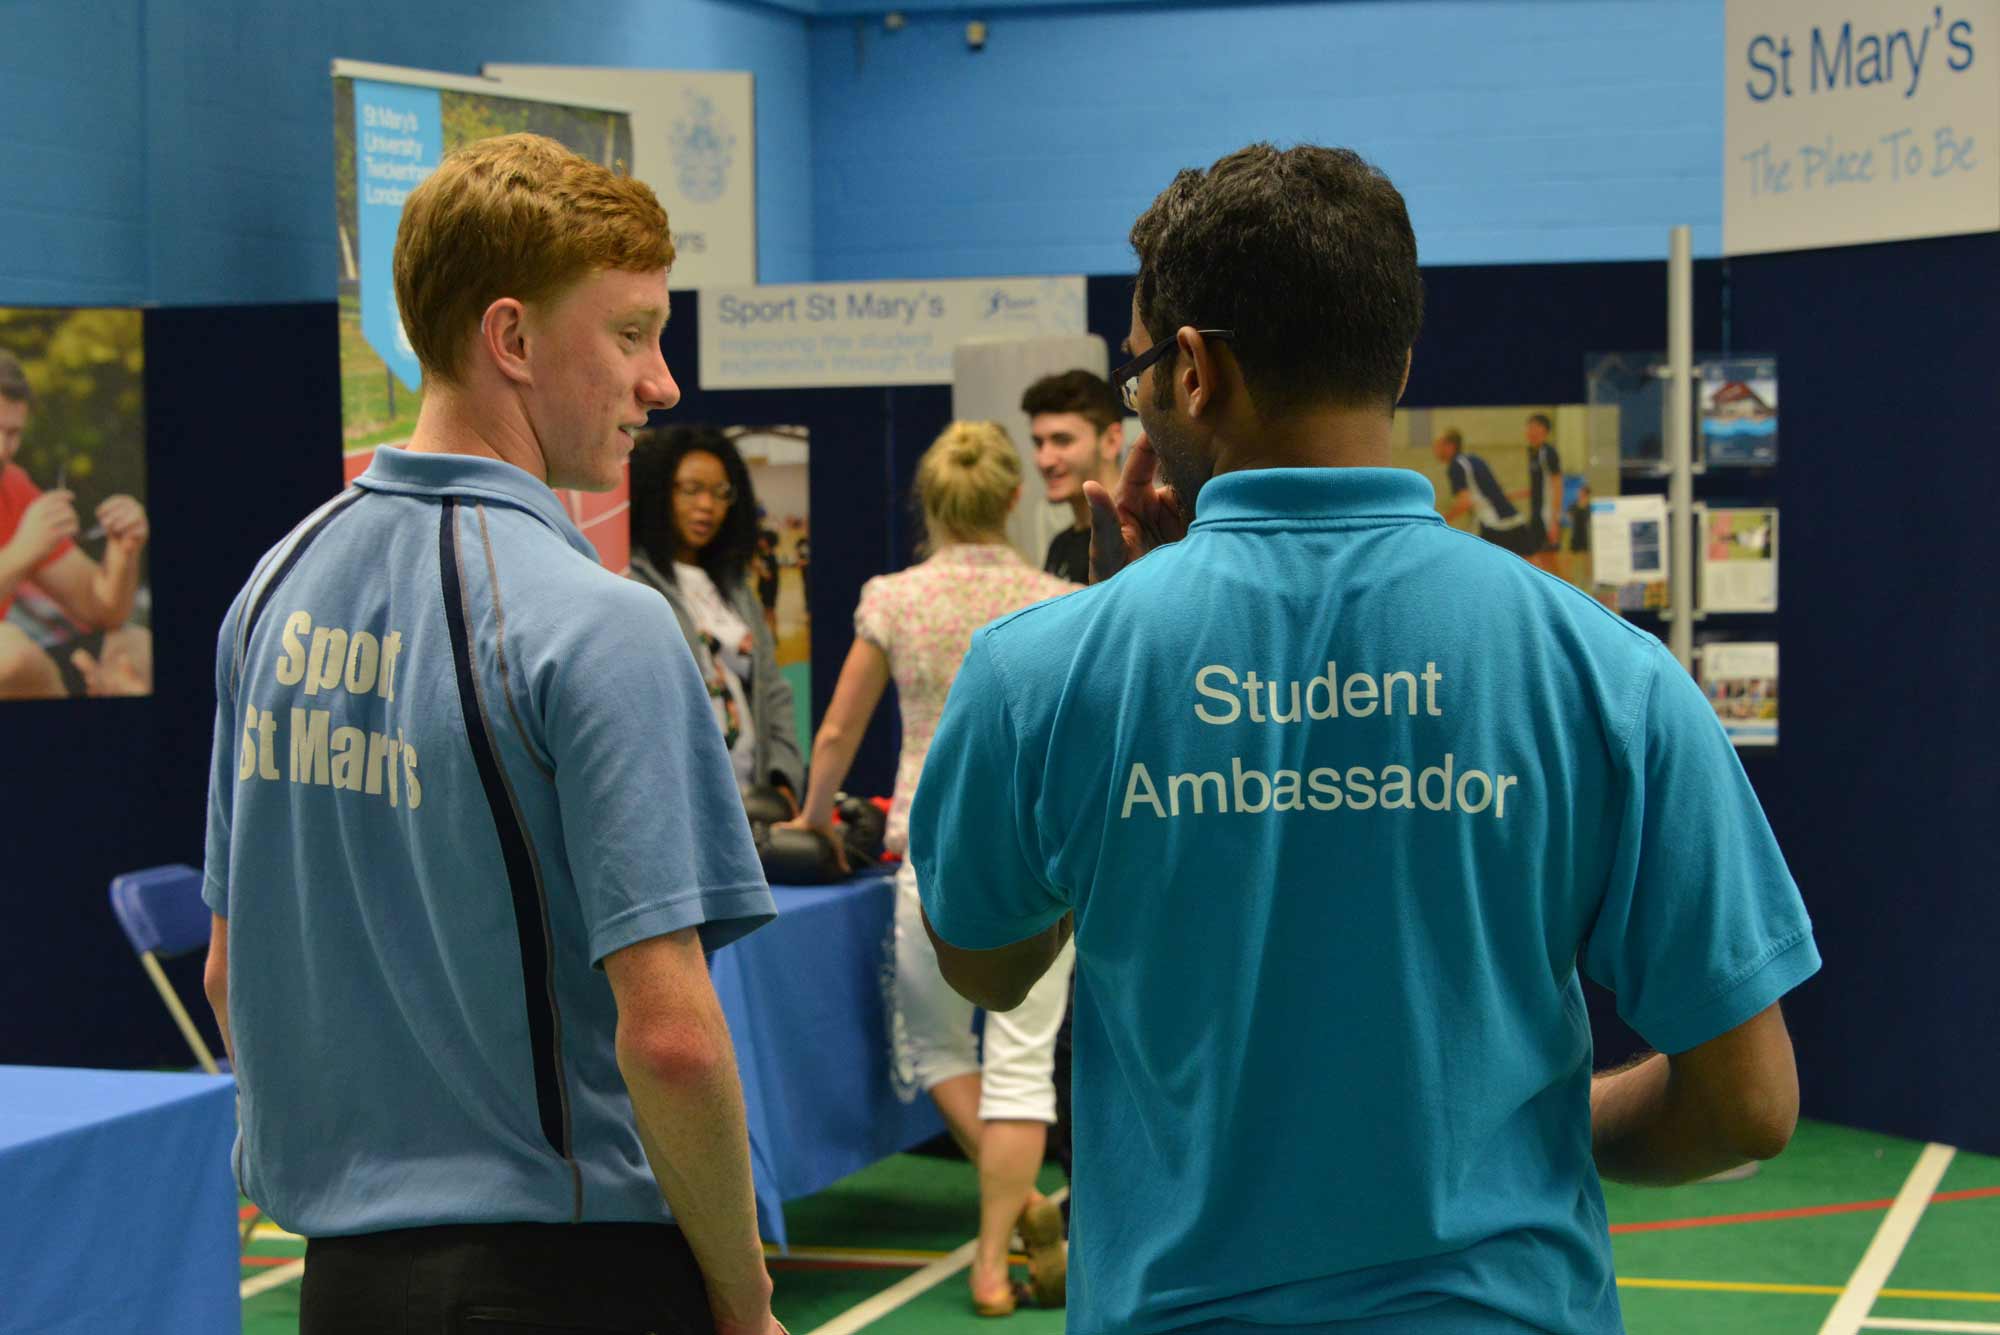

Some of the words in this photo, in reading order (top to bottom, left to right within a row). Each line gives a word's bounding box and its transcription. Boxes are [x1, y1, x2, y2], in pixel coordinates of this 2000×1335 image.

[1745, 34, 1794, 102] St
[1809, 5, 1976, 99] Mary's
[1742, 142, 1793, 195] The
[1797, 130, 1874, 189] Place
[1878, 126, 1923, 183] To
[1929, 126, 1982, 178] Be
[719, 293, 798, 329] Sport
[806, 292, 838, 321] St
[846, 287, 948, 325] Mary's
[276, 610, 402, 703] Sport
[1193, 660, 1443, 726] Student
[239, 703, 280, 781] St
[1120, 752, 1519, 819] Ambassador
